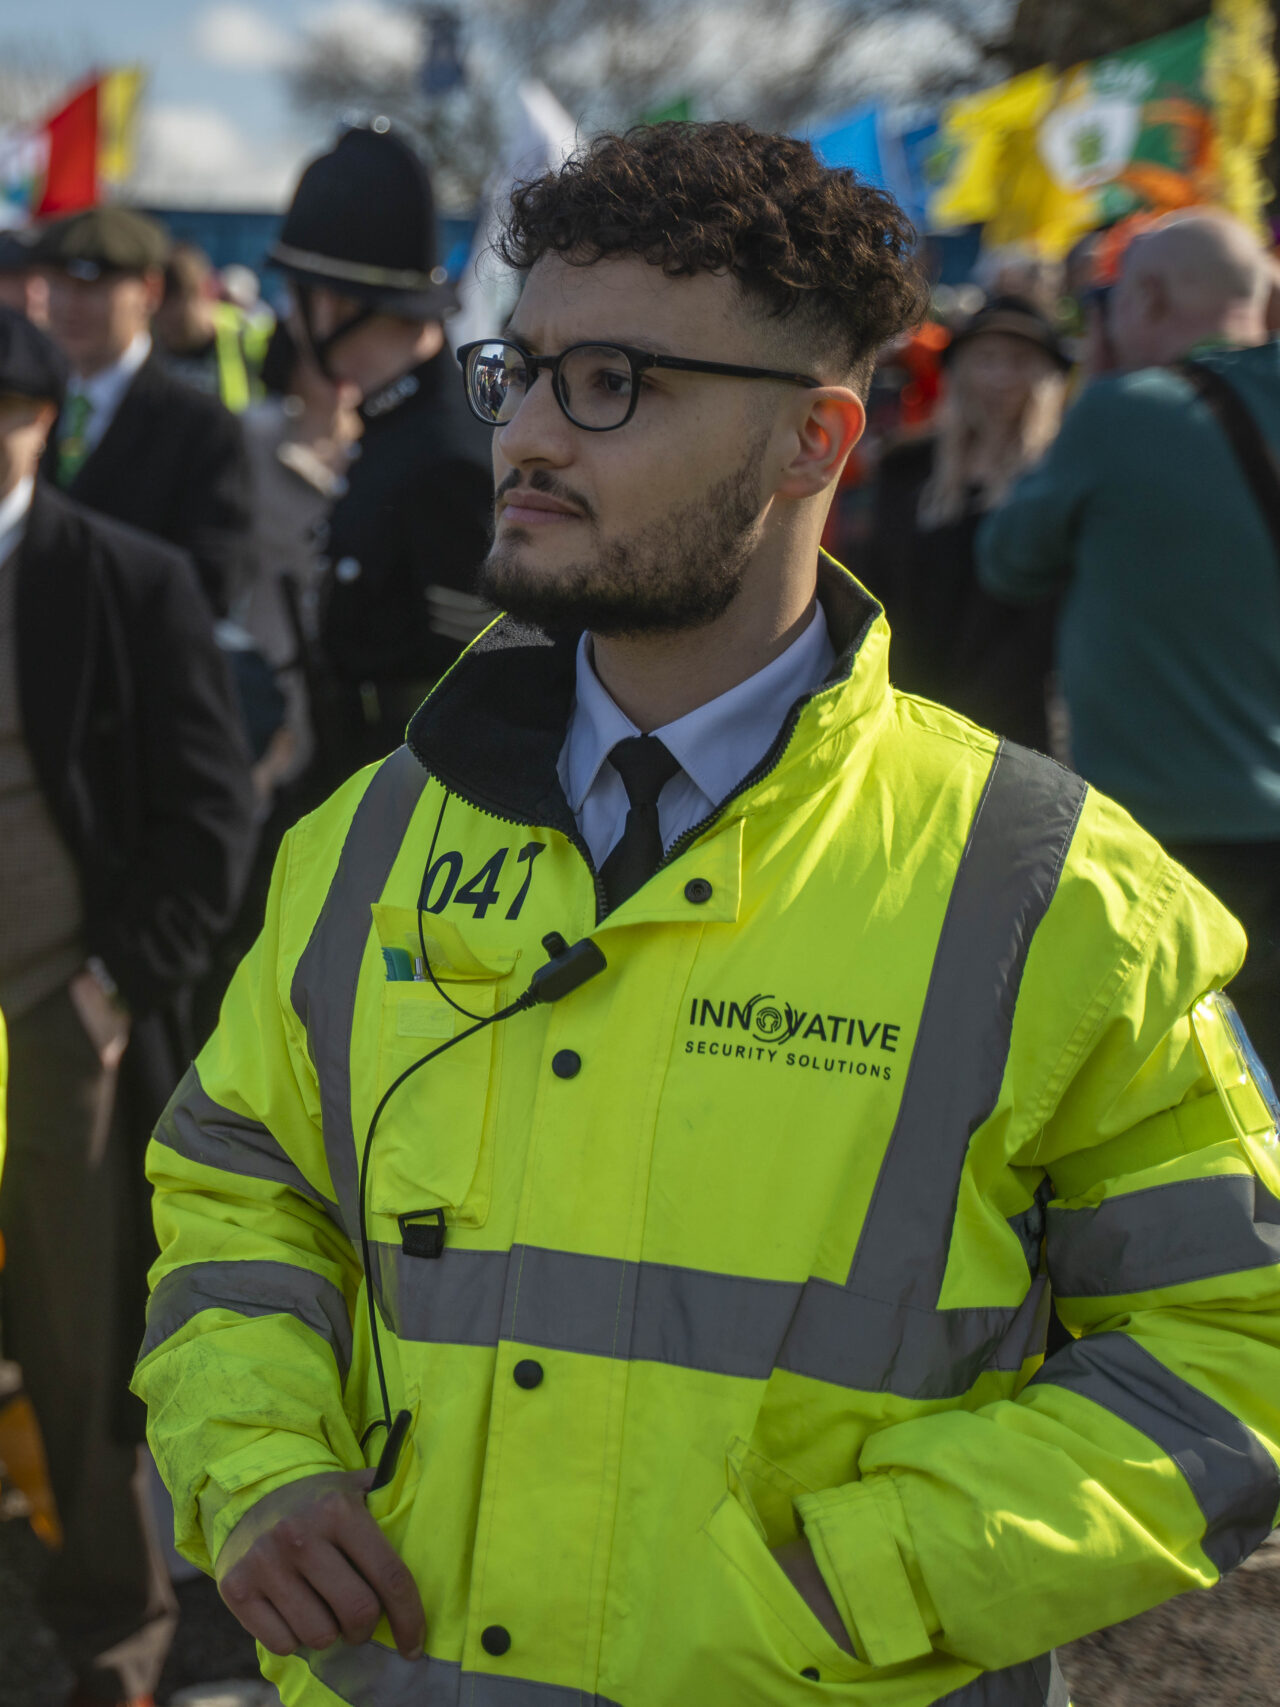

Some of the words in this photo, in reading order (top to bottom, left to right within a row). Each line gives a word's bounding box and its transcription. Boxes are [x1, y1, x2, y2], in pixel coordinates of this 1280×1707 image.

[689, 993, 901, 1053] INNOVATIVE
[685, 1040, 778, 1062] SECURITY
[785, 1052, 892, 1081] SOLUTIONS
